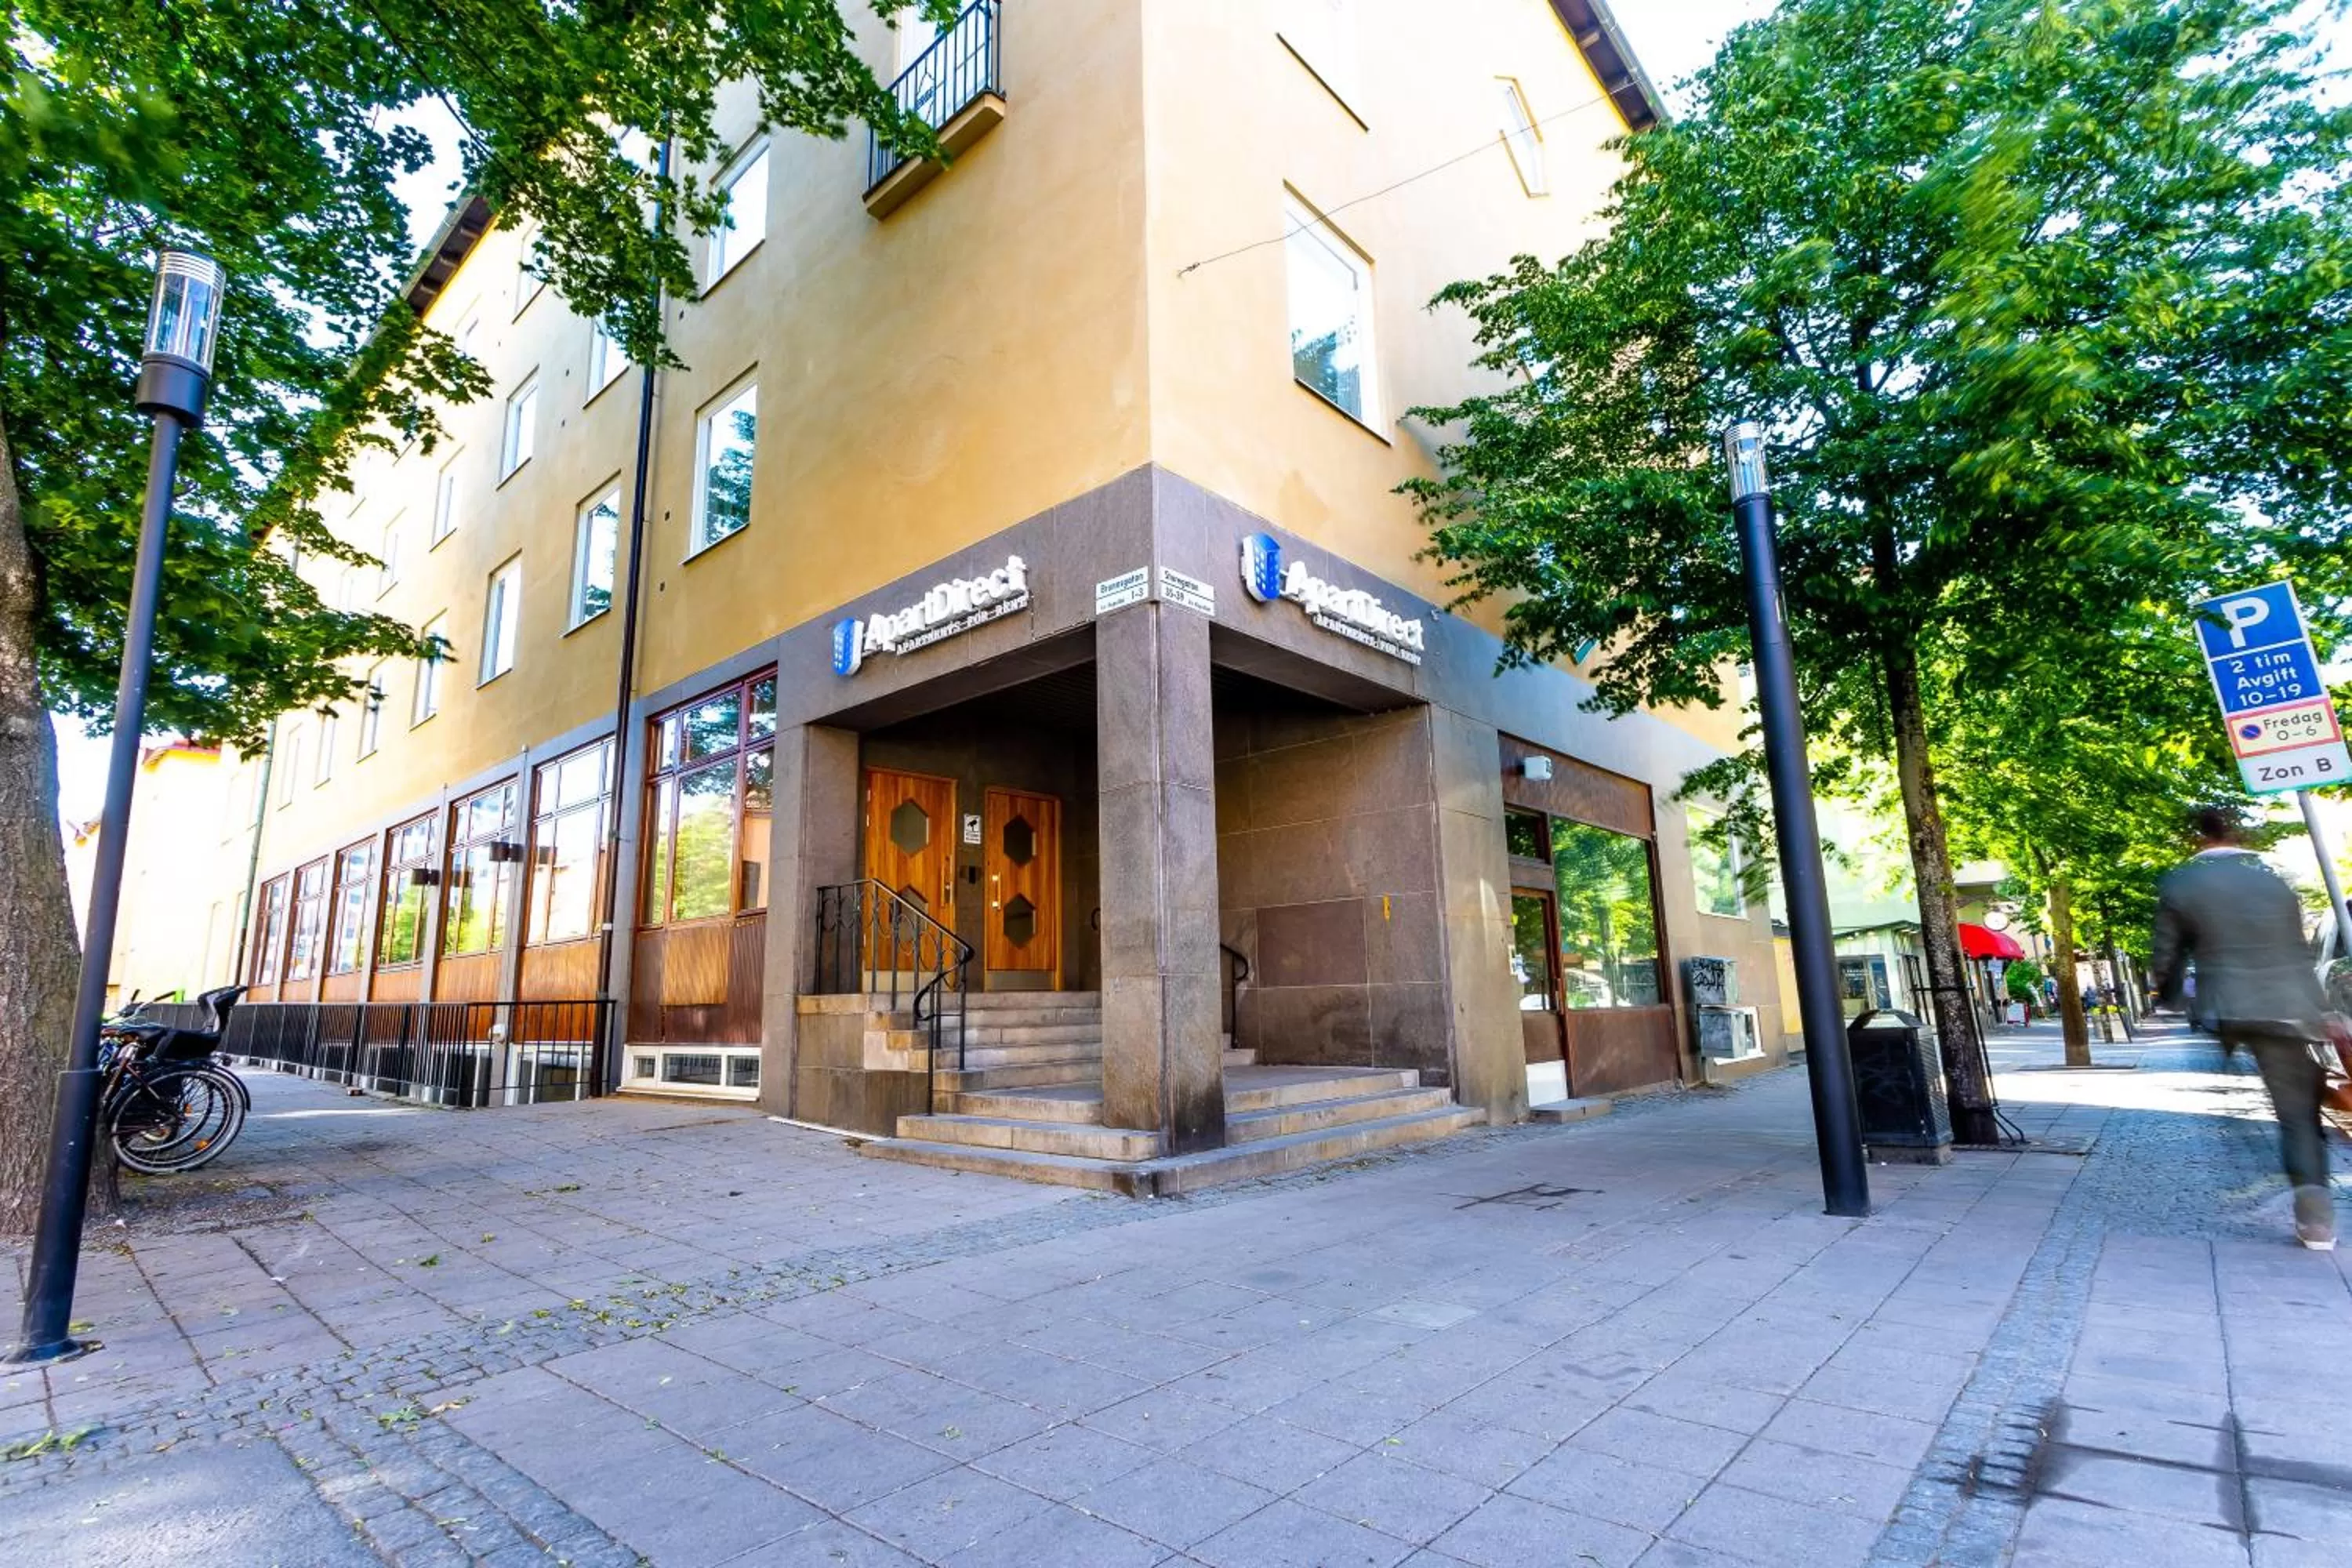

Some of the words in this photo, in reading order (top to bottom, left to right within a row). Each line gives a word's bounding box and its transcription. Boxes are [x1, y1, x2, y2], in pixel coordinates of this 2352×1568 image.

[864, 555, 1027, 652] ApartDirect
[1284, 561, 1425, 651] ApartDirect
[2220, 596, 2270, 648] P
[2230, 660, 2245, 673] 2
[2255, 652, 2292, 668] tim
[2237, 666, 2299, 690] Avgift
[2239, 683, 2302, 706] 10-19
[2263, 712, 2323, 730] Fredag
[2258, 765, 2304, 782] Zon
[2316, 757, 2332, 772] B
